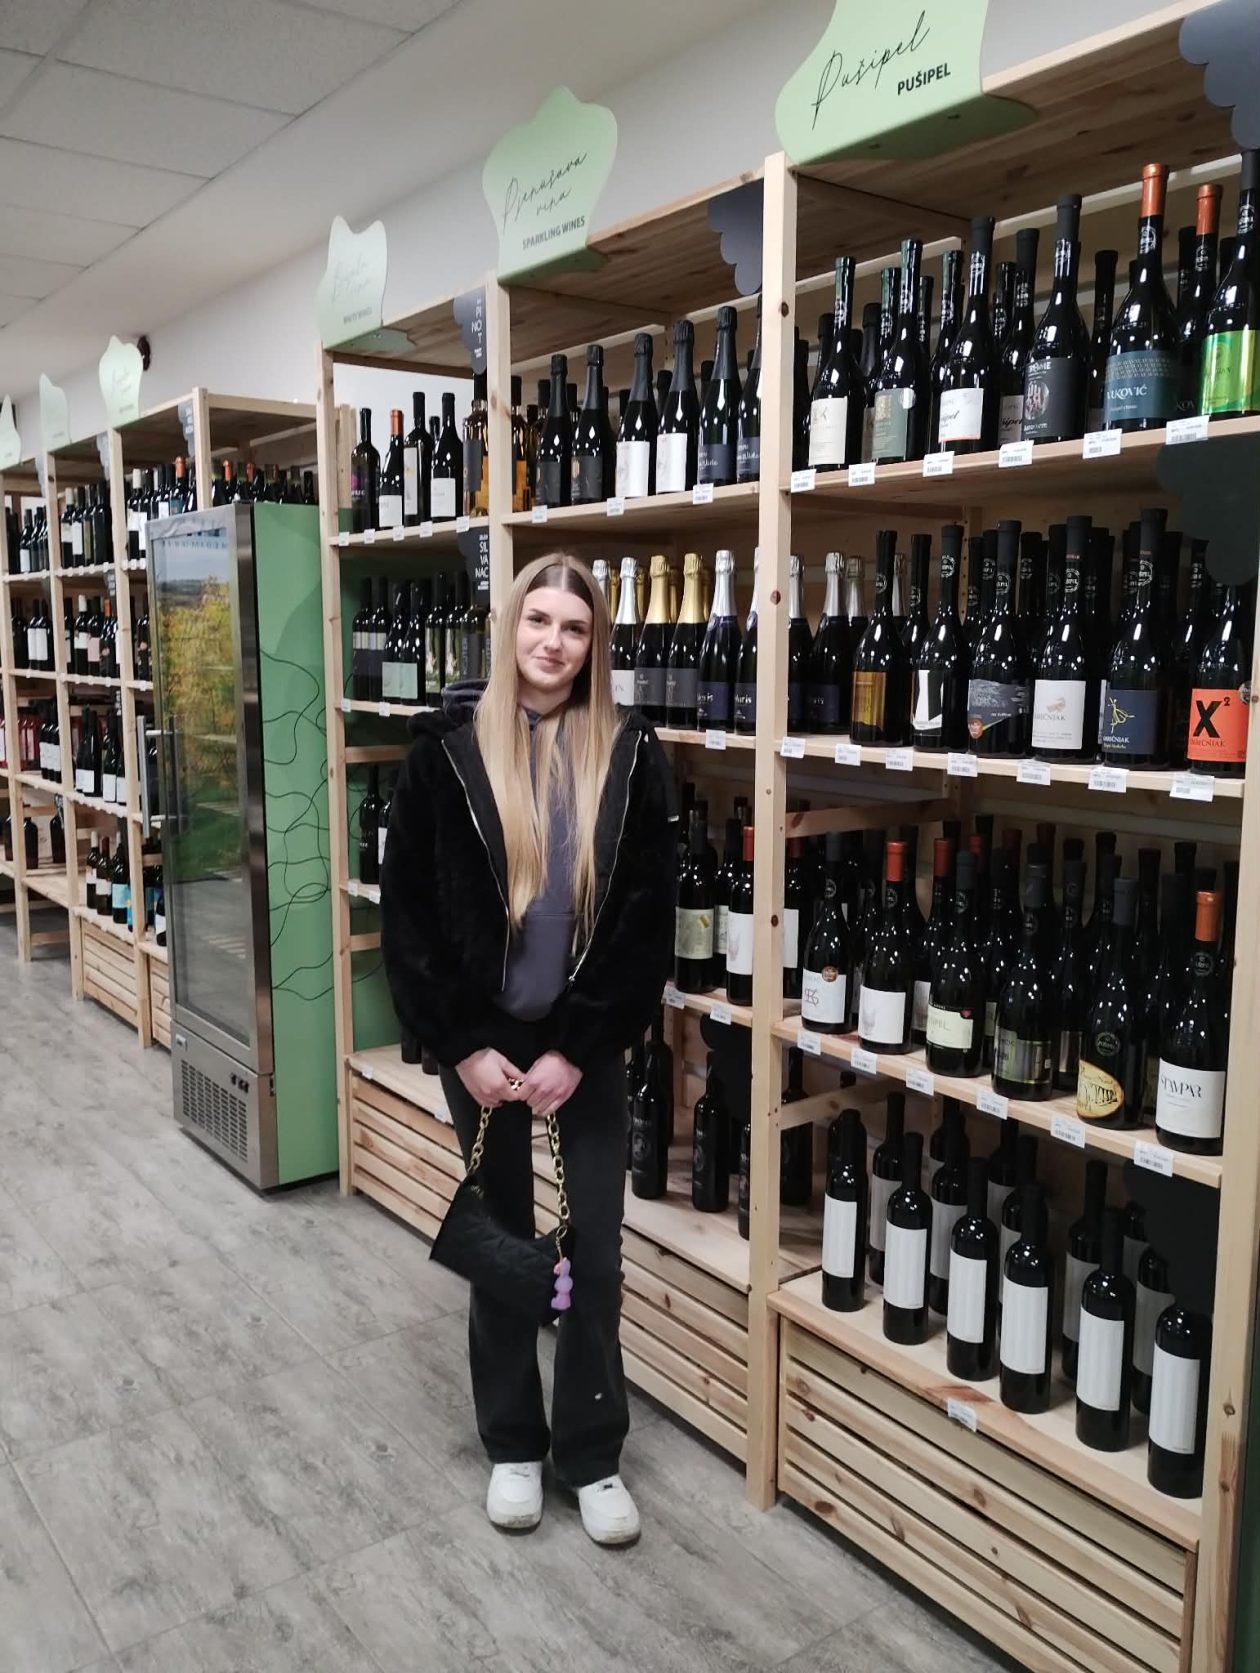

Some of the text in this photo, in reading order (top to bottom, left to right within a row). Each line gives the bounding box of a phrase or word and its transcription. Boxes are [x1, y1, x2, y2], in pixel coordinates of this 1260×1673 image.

[811, 10, 931, 131] Pušipel
[897, 62, 951, 96] PUŠIPEL
[522, 215, 586, 250] SPARKLING WINES
